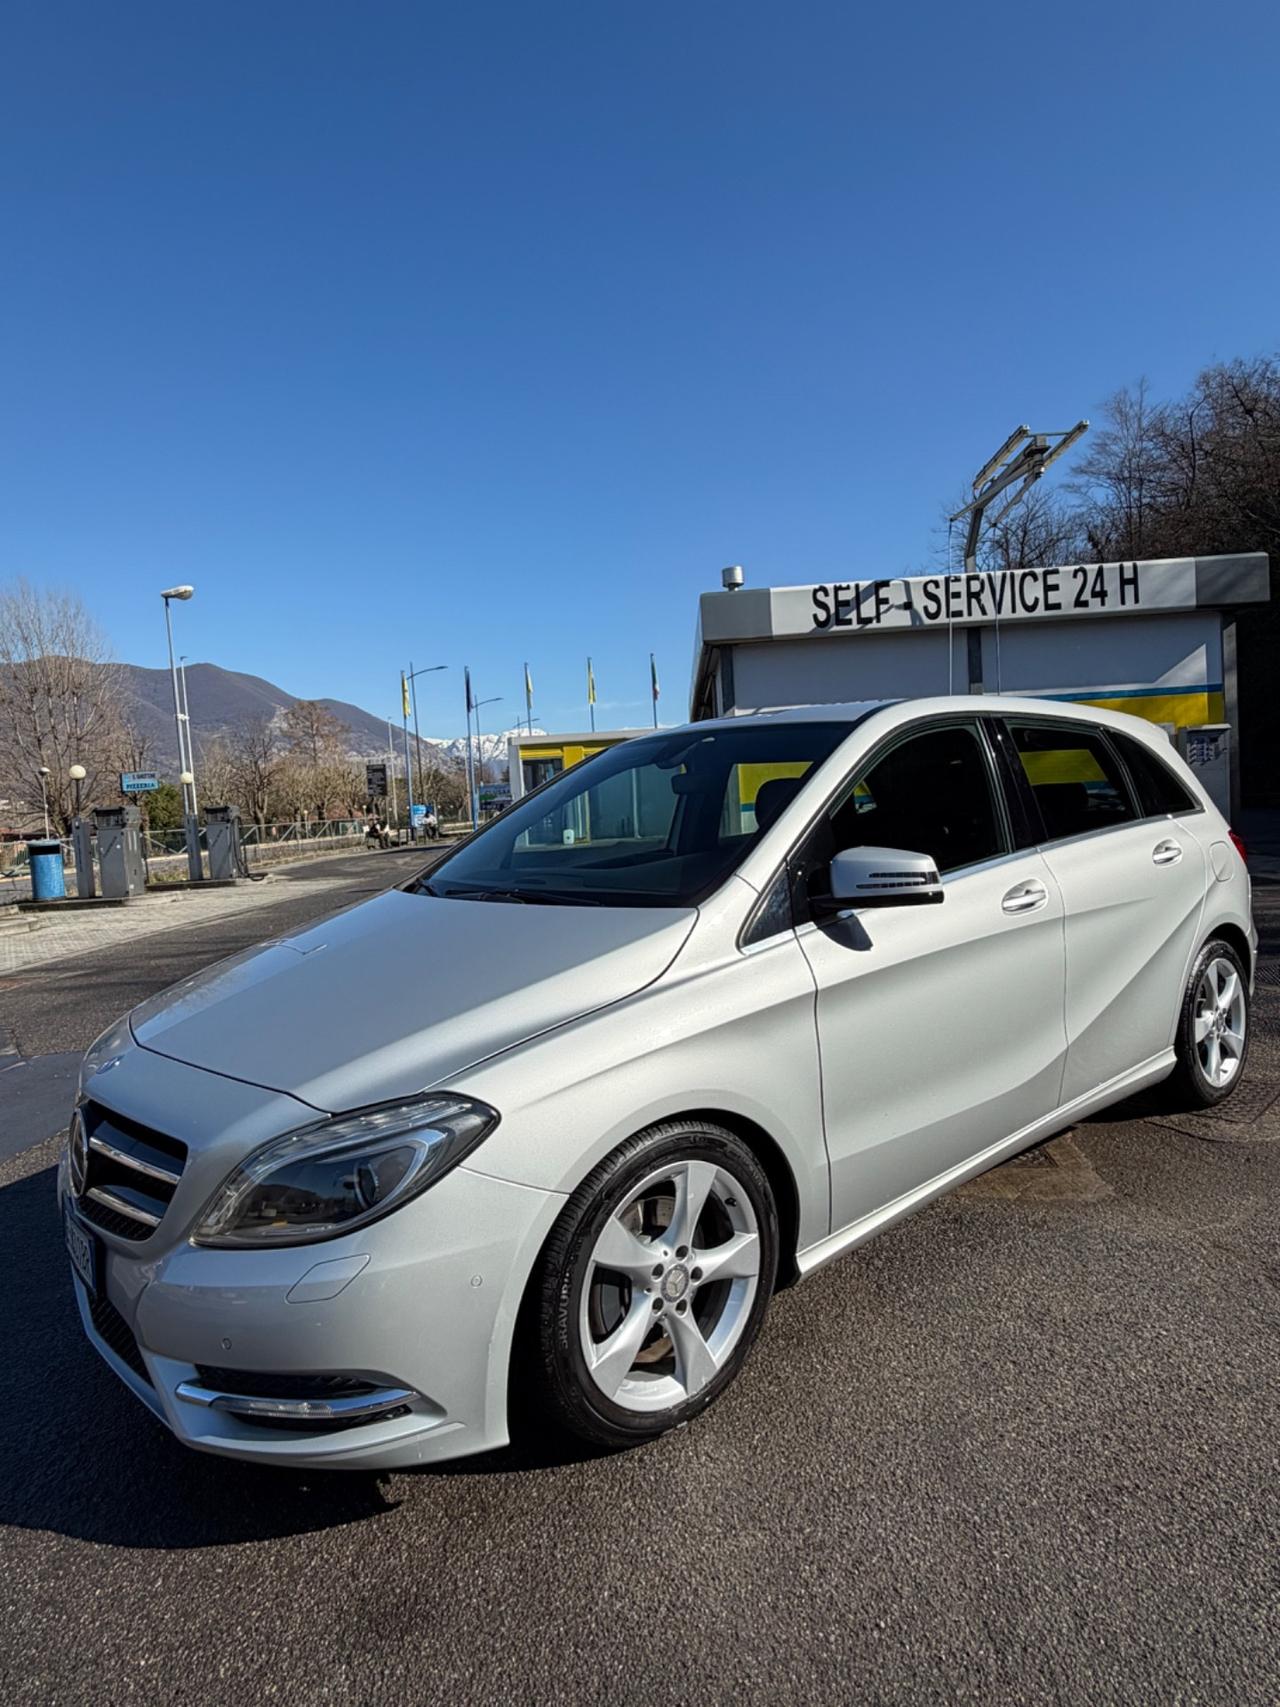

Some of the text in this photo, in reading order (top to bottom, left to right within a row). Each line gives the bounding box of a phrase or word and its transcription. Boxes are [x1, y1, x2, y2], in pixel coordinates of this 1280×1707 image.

[812, 580, 890, 629] SELF
[922, 568, 1062, 621] SERVICE
[1072, 565, 1108, 609] 24
[1119, 562, 1140, 606] H
